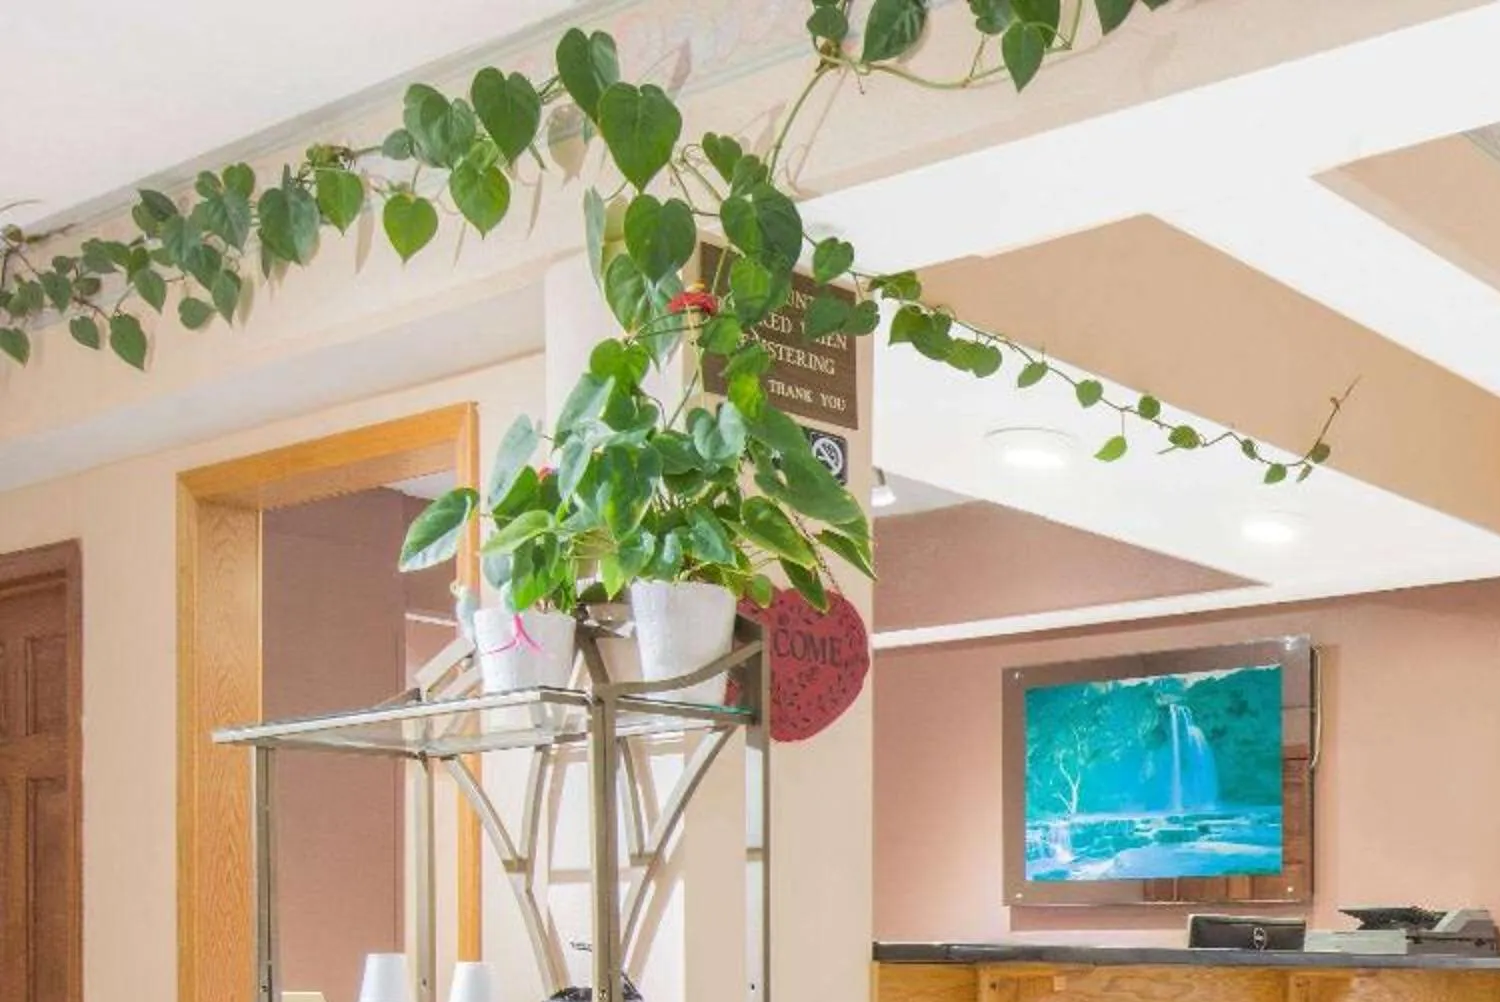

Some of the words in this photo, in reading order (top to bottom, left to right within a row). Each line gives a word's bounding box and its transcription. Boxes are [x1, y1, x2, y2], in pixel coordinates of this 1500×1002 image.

[768, 380, 813, 403] THANK
[820, 392, 846, 411] YOU
[773, 628, 841, 667] COME
